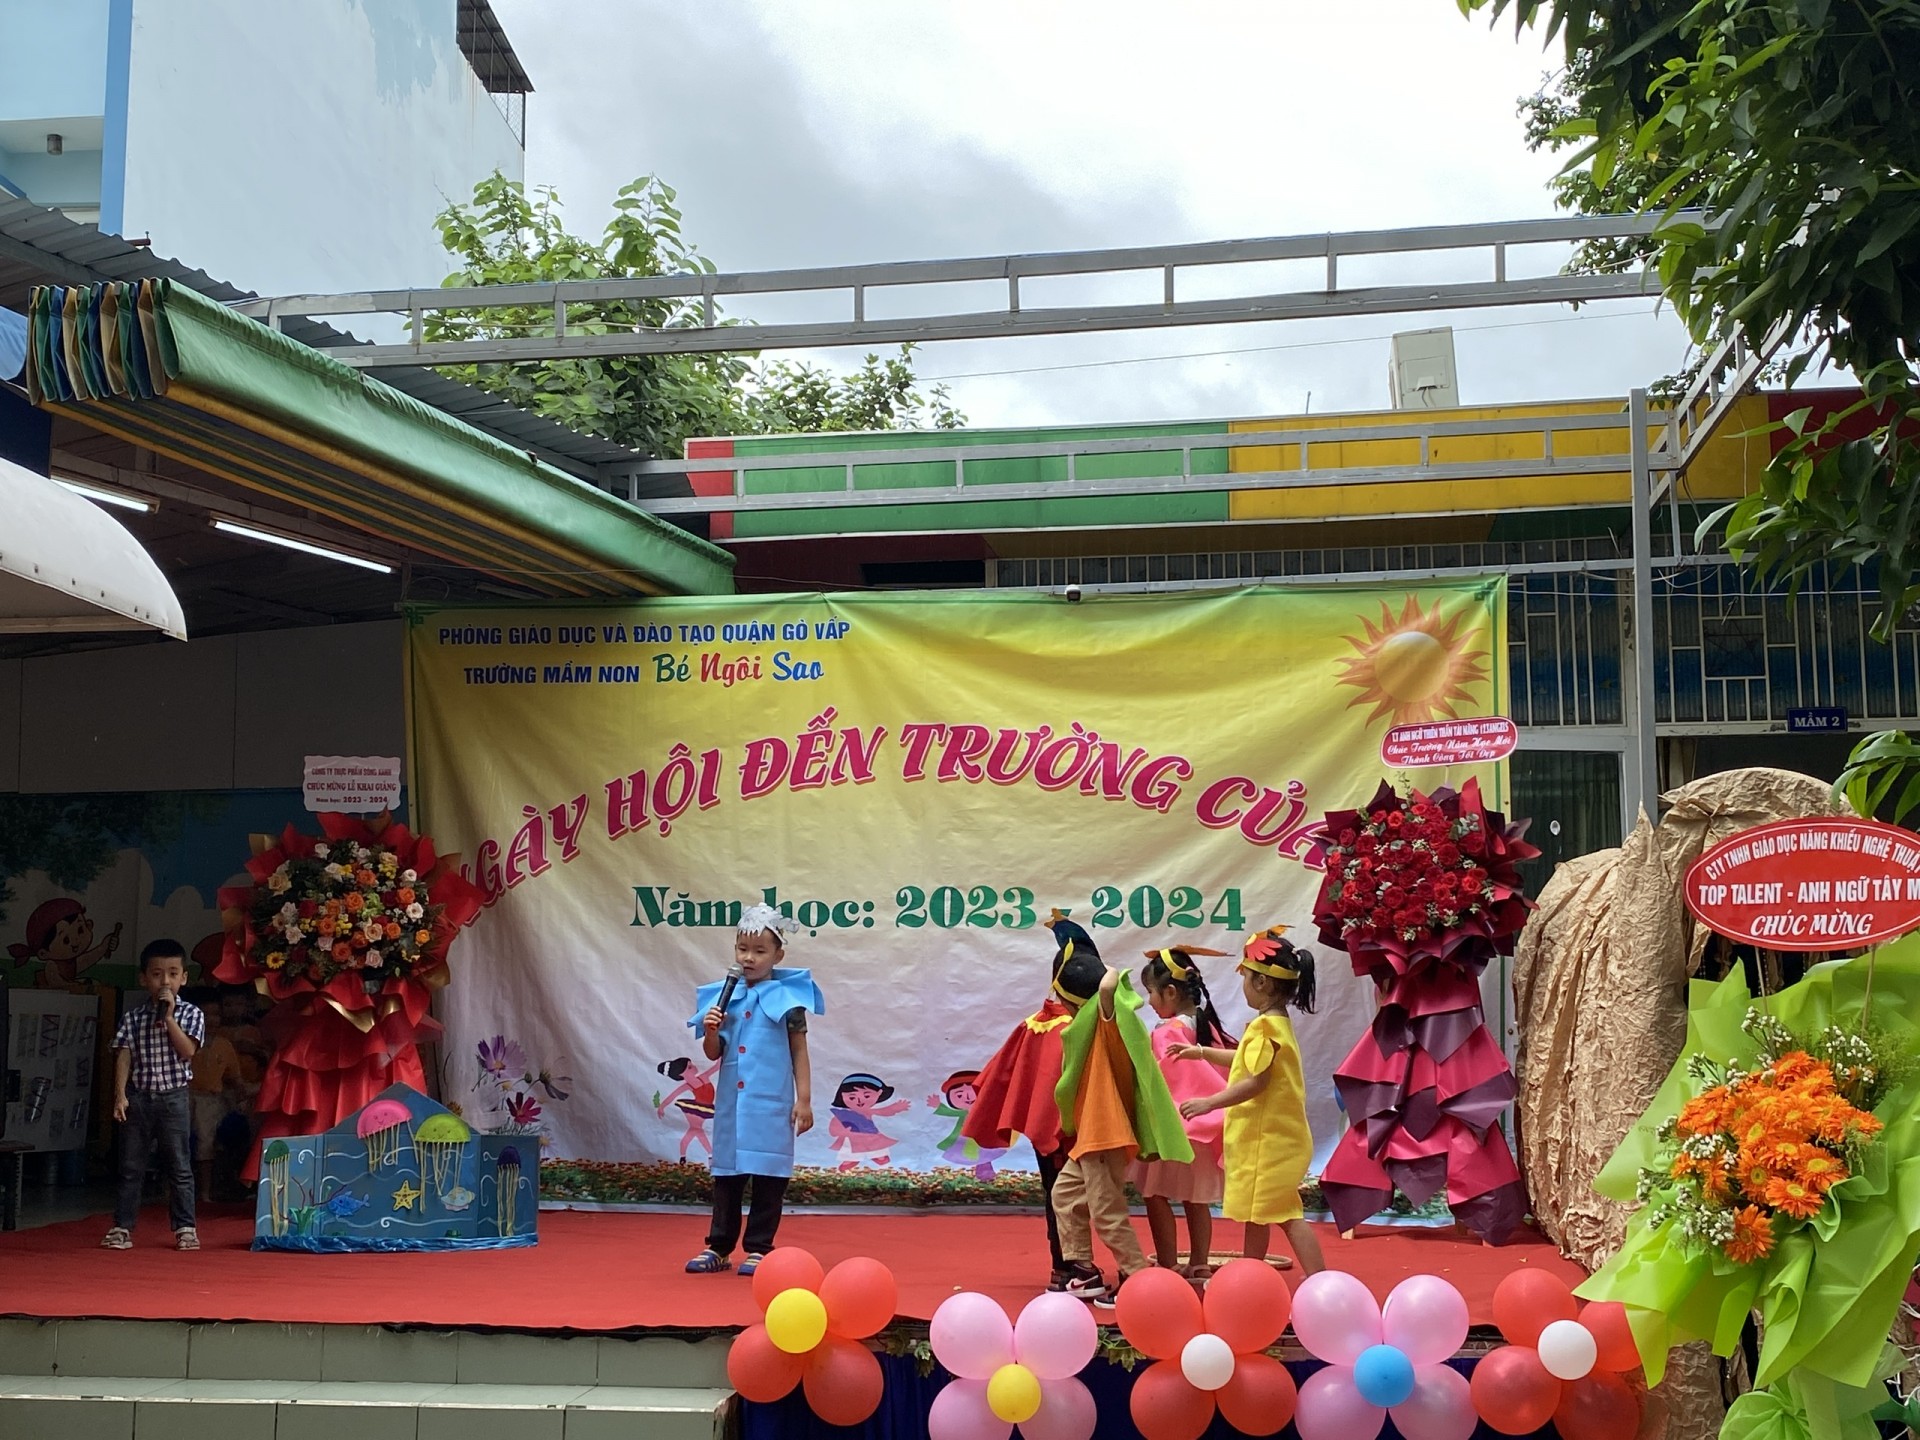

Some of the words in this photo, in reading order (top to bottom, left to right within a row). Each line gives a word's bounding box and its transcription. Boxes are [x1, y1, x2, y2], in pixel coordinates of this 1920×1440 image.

[440, 623, 502, 645] PHÒNG
[508, 624, 551, 645] GIÁO
[558, 626, 596, 648] DỤC
[602, 622, 628, 643] VÀ
[633, 622, 672, 643] ĐÀO
[679, 625, 715, 646] TẠO
[722, 620, 775, 645] QUẬN
[782, 618, 808, 641] GÒ
[815, 615, 850, 640] VẤP
[464, 661, 537, 685] TRƯỜNG
[543, 659, 592, 684] MẦM
[598, 665, 640, 683] NON
[652, 653, 692, 683] Bé
[700, 652, 763, 688] Ngôi
[772, 651, 825, 681] Sao
[1794, 712, 1828, 728] MẦM
[1831, 716, 1840, 727] 2
[307, 781, 325, 791] CHÚC
[357, 782, 374, 791] KHAI
[604, 742, 723, 839] HỘI
[739, 705, 888, 799] ĐẾN
[900, 721, 1193, 813] TRƯỜNG
[1705, 857, 1726, 880] CTY
[1723, 843, 1751, 869] TNHH
[1752, 835, 1775, 860] GIÁO
[1776, 833, 1798, 857] DỤC
[1800, 828, 1828, 850] NĂNG
[1829, 827, 1861, 853] KHIẾU
[1862, 836, 1893, 862] NGHỆ
[1699, 884, 1728, 905] TOP
[1731, 882, 1784, 905] TALENT
[1797, 881, 1830, 903] ANH
[1835, 875, 1869, 903] NGỮ
[1873, 874, 1903, 901] TÂY
[629, 886, 742, 928] Năm
[896, 885, 1037, 929] 2023
[1091, 885, 1246, 931] 2024
[1750, 909, 1807, 937] CHÚC
[1808, 908, 1874, 937] MỪNG
